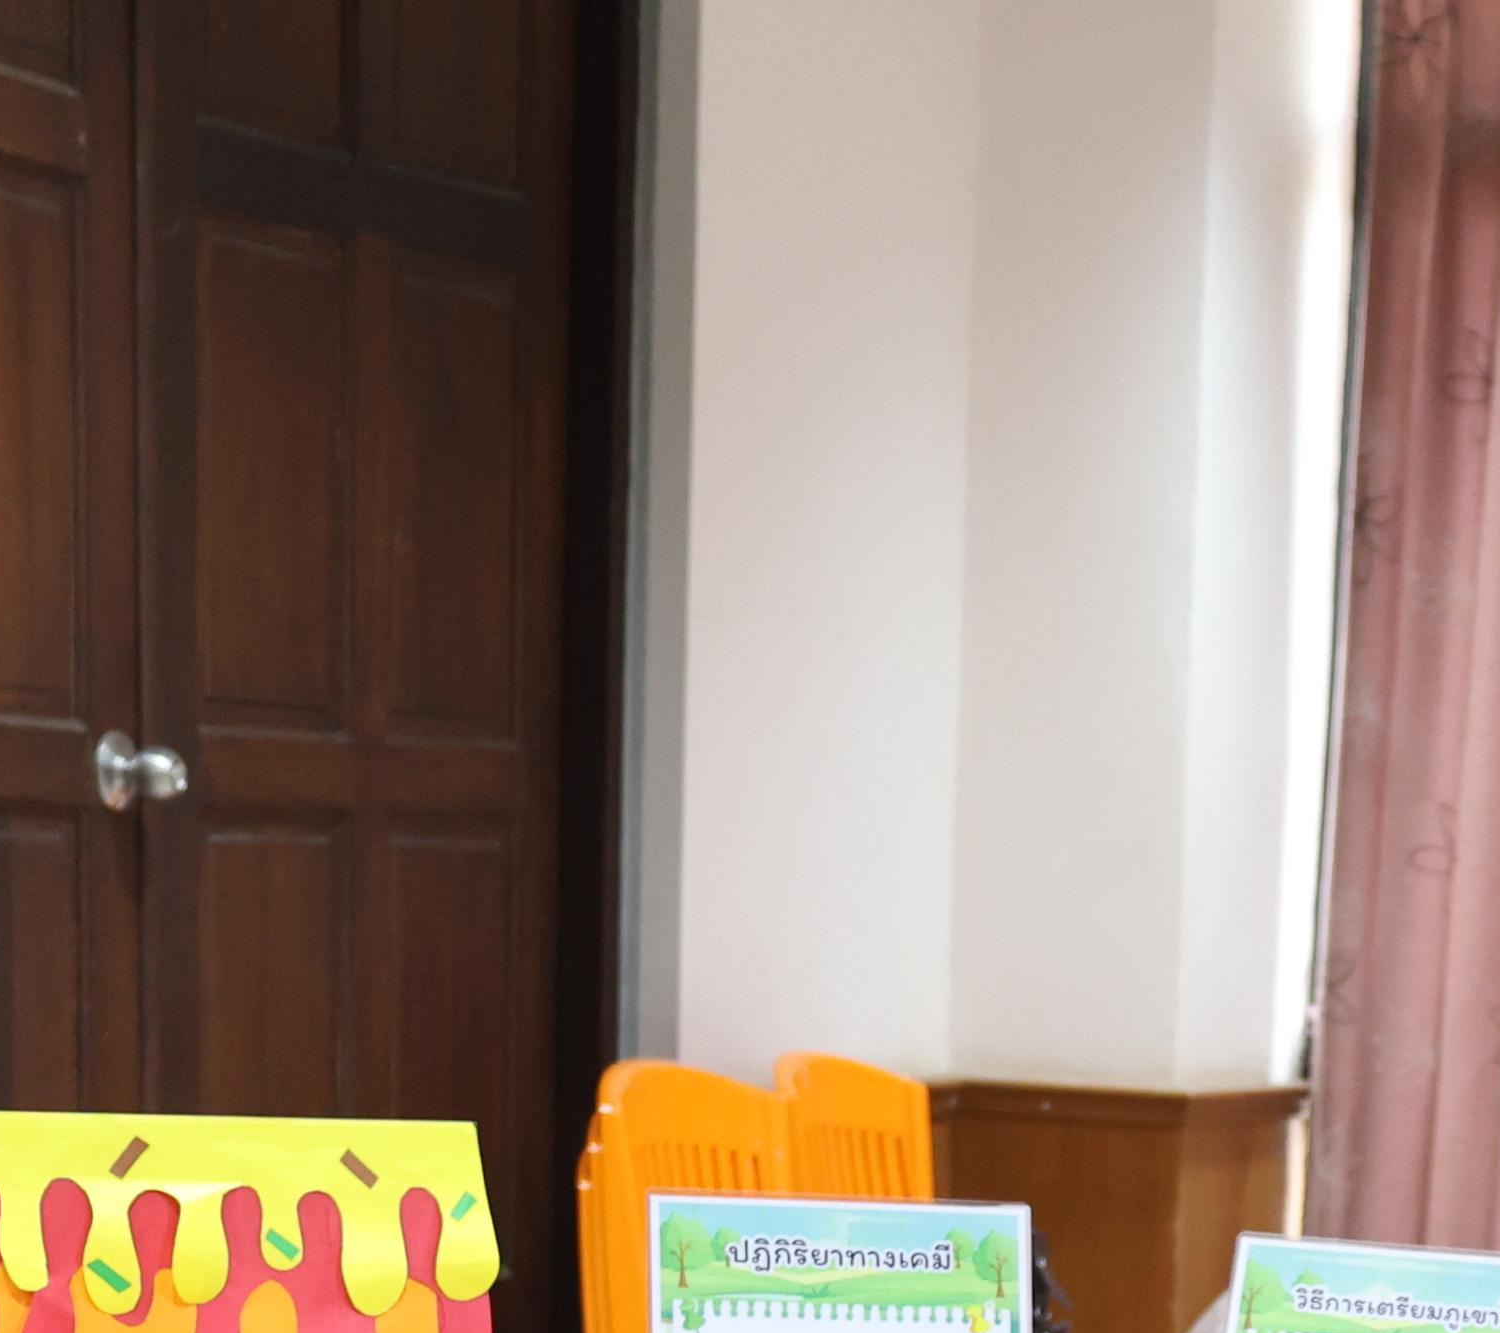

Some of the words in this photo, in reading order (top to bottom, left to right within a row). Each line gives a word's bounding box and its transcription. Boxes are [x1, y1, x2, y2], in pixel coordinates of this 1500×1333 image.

[728, 1238, 952, 1271] ปฏิกิริยาทางเคมี
